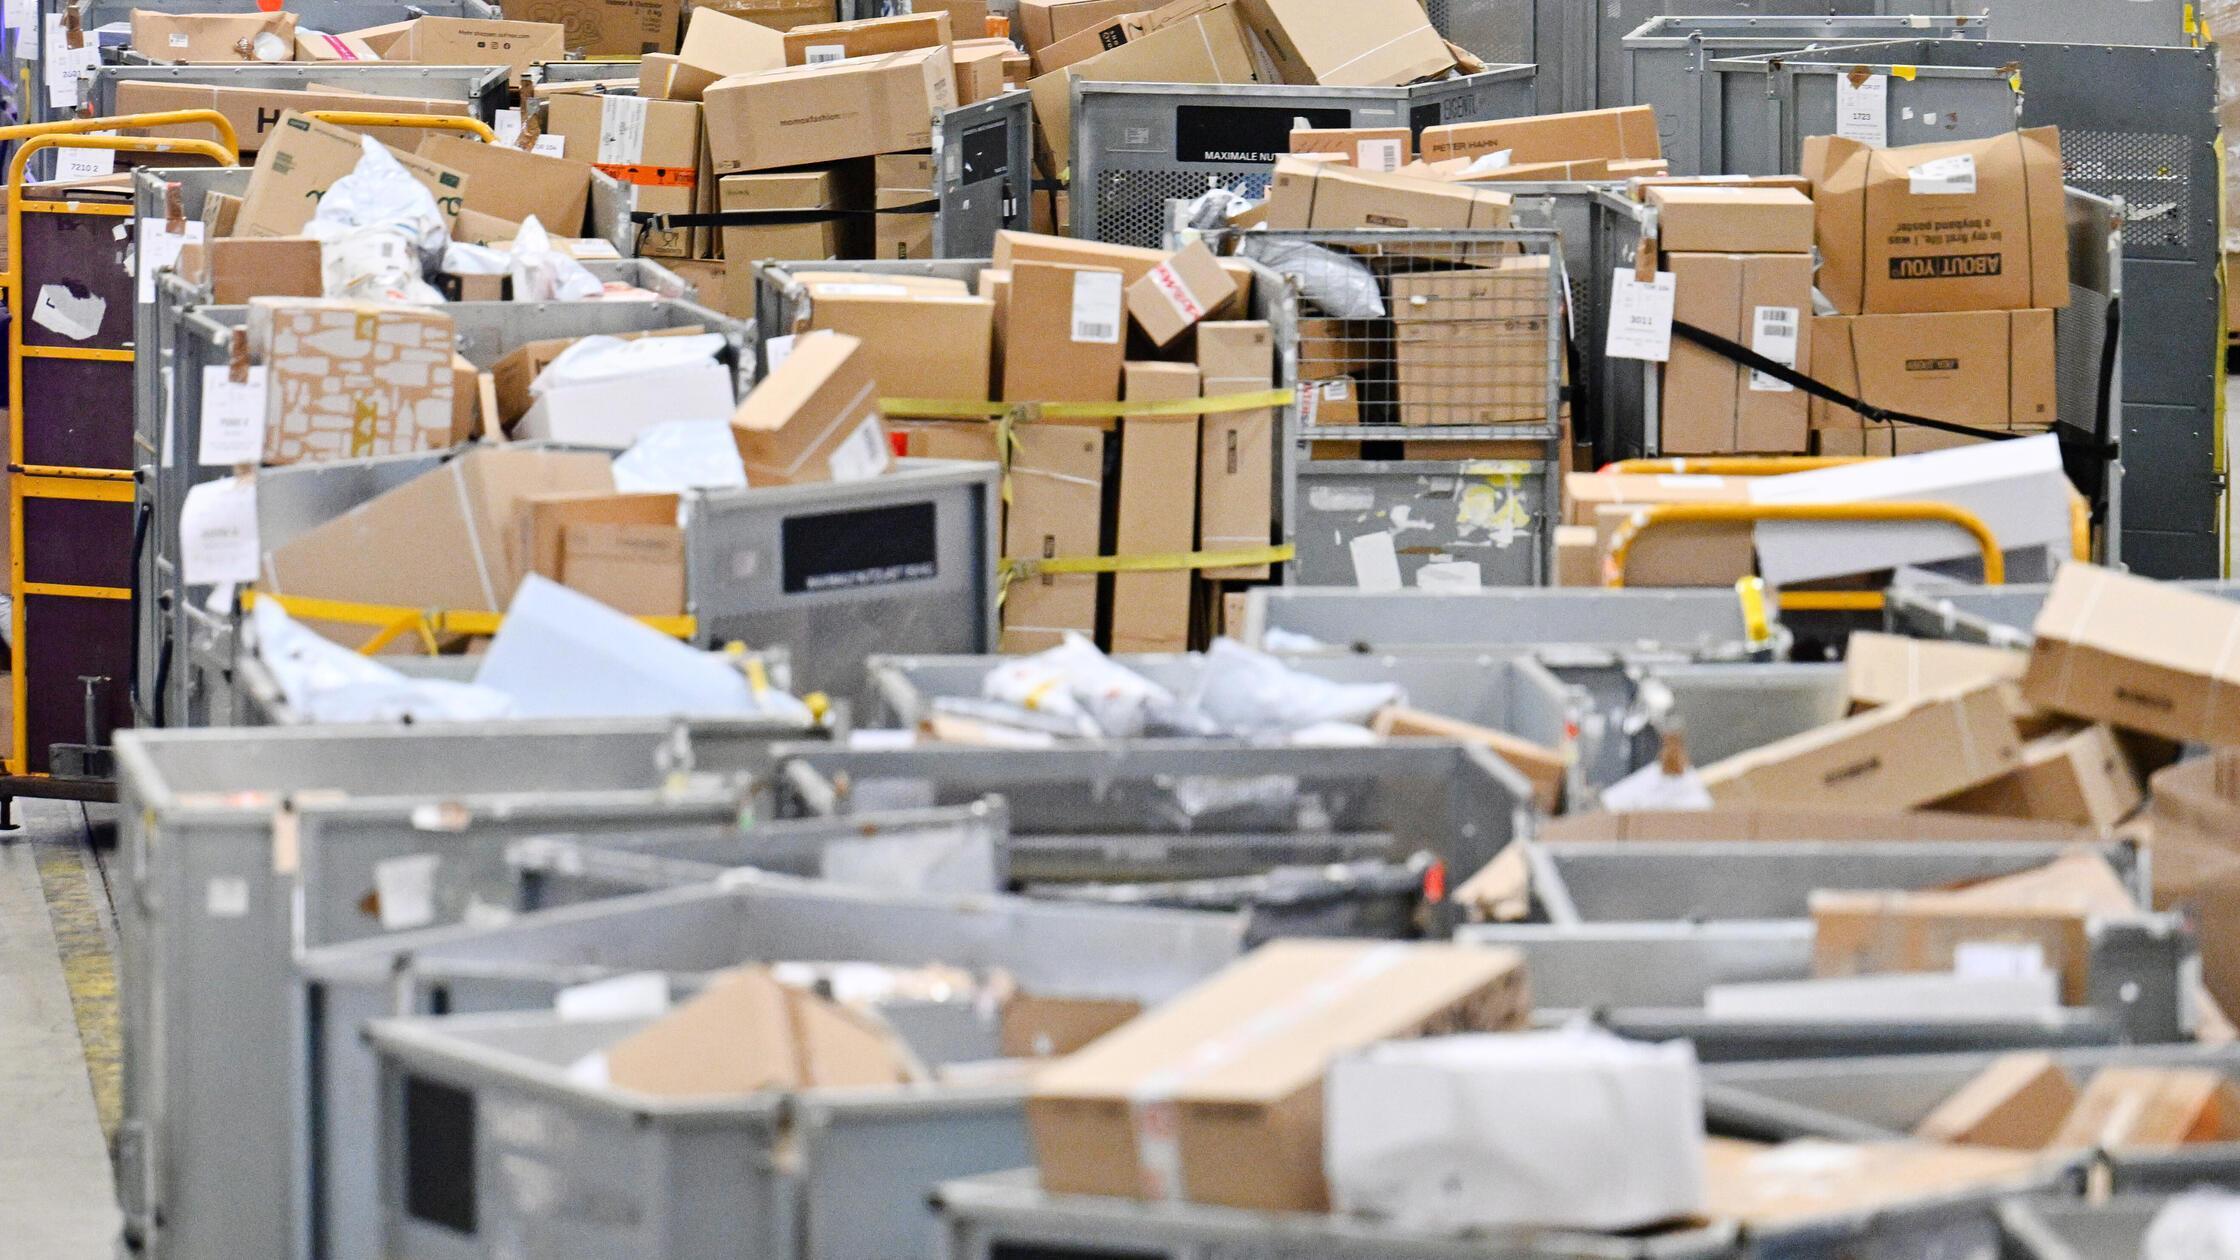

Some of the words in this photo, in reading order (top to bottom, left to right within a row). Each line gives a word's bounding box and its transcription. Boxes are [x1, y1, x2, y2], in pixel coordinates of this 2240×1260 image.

[1432, 142, 1467, 152] PETER
[1467, 139, 1499, 149] HAHN
[1203, 151, 1258, 162] MAXIMALE
[1900, 259, 1936, 277] YOU
[1941, 255, 2000, 276] ABOUT
